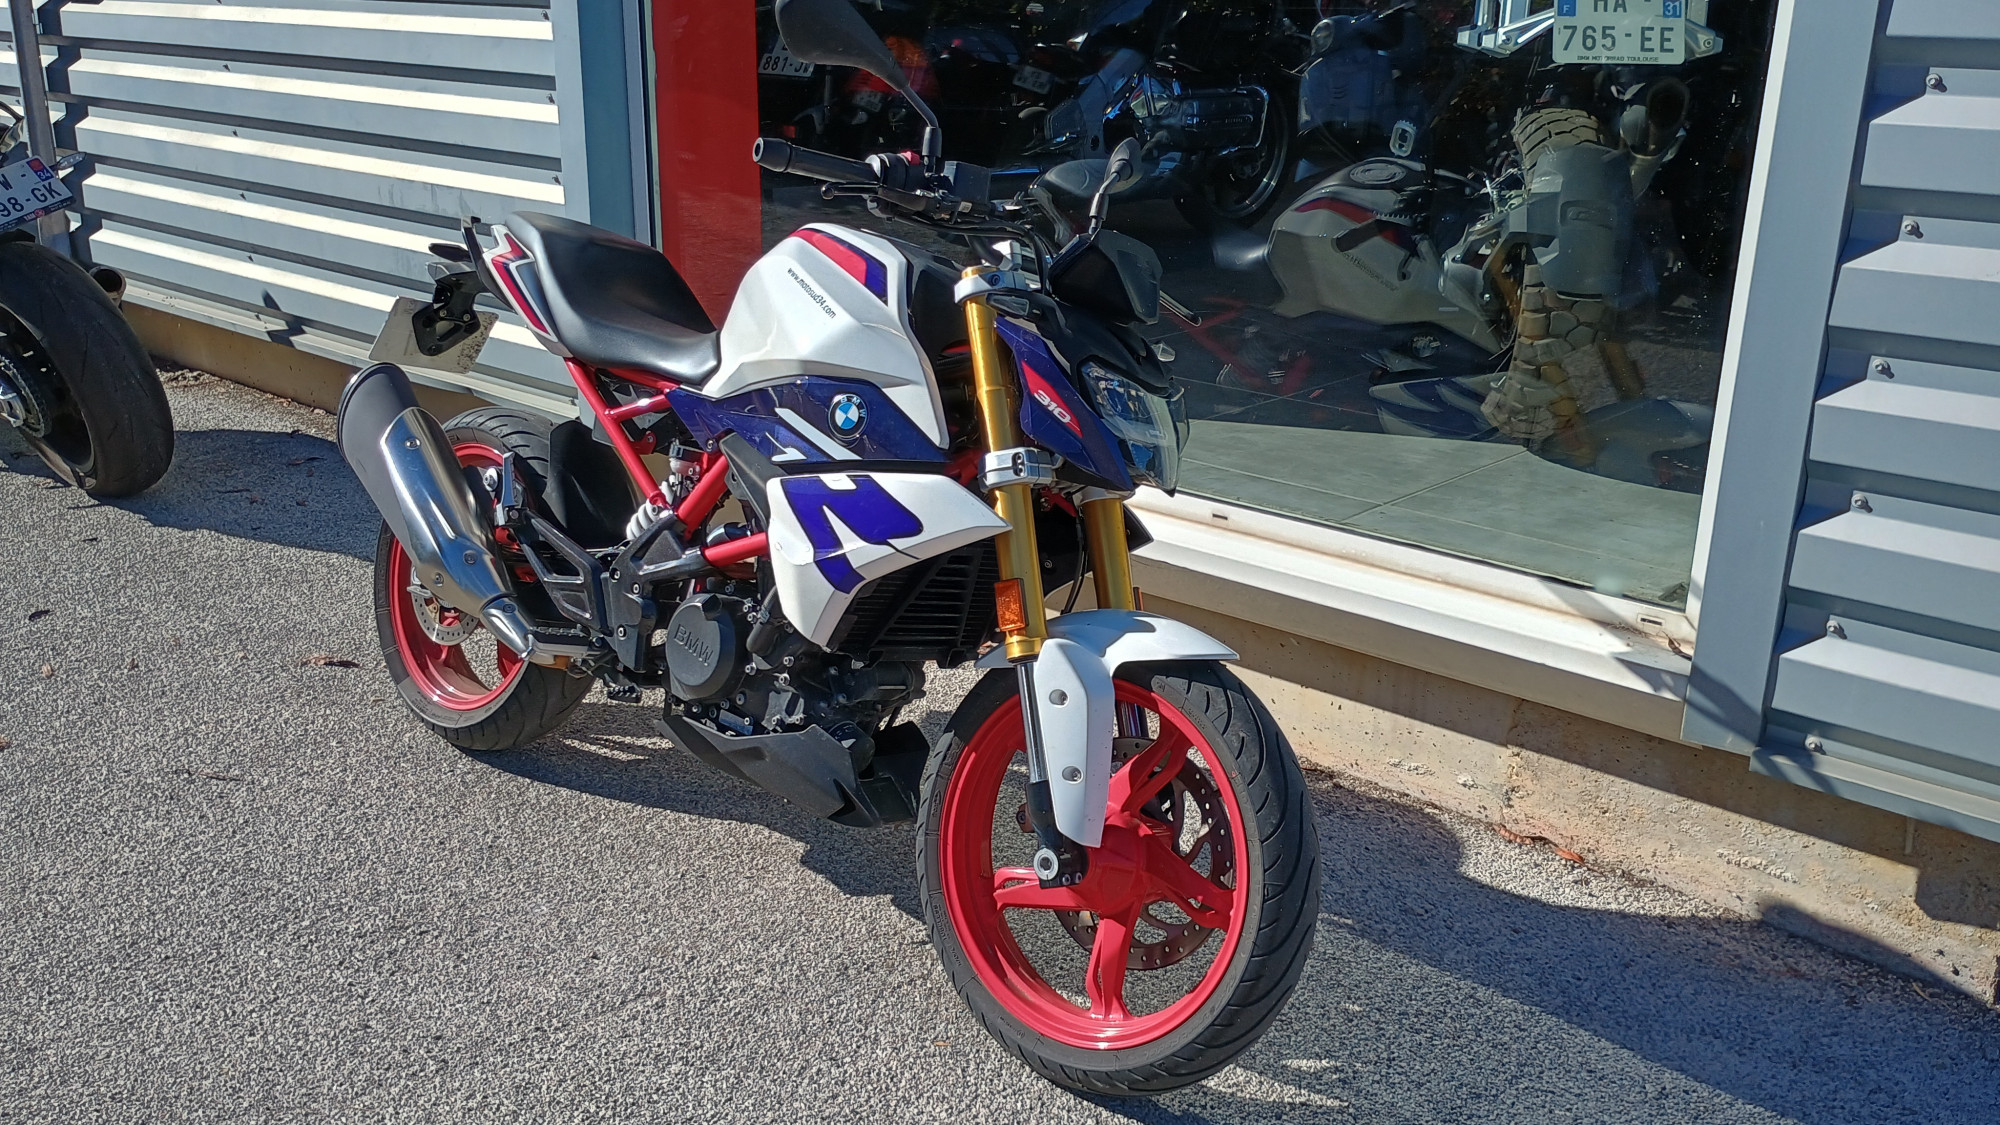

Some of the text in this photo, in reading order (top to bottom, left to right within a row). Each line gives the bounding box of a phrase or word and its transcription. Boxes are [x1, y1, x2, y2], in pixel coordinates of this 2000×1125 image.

[1563, 5, 1570, 13] F
[1664, 1, 1680, 16] 31
[1562, 25, 1675, 53] 765-EE
[37, 170, 51, 180] 34
[787, 267, 836, 319] www.motosud34.com
[1034, 389, 1071, 423] 310
[674, 623, 714, 666] BMW
